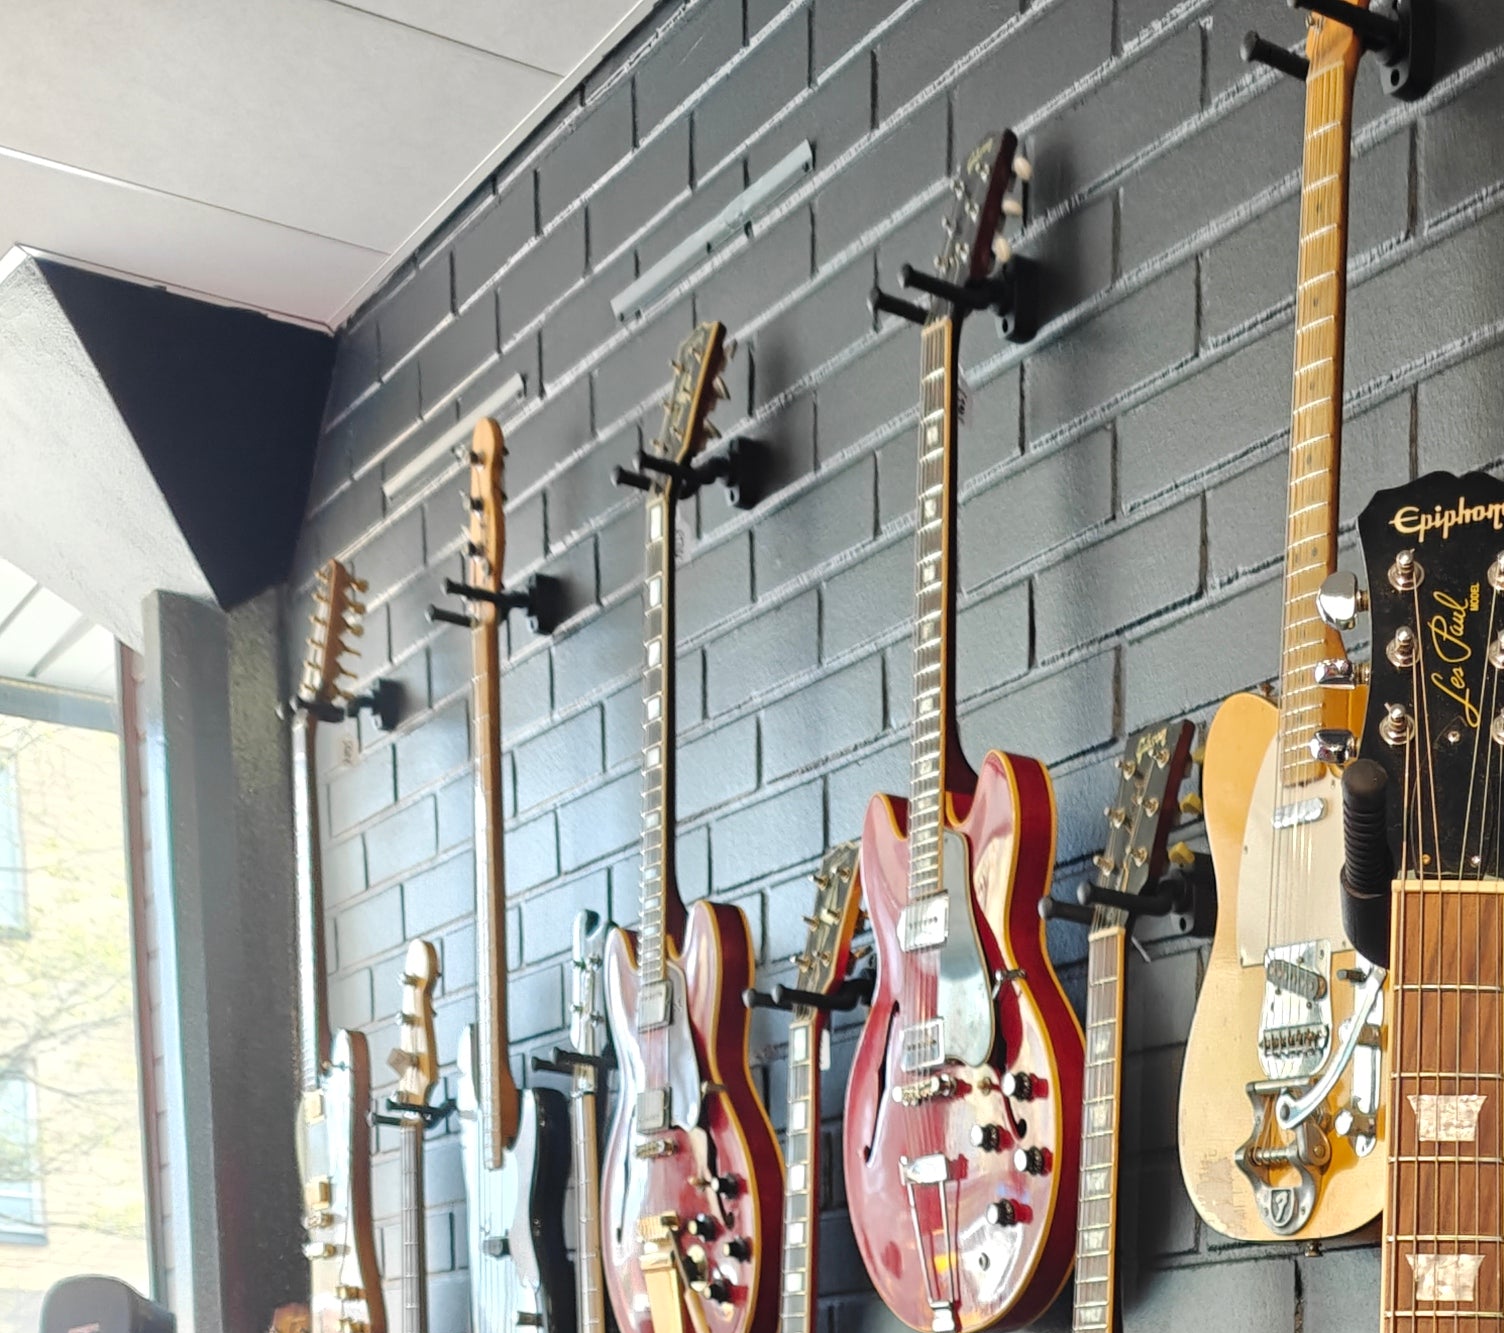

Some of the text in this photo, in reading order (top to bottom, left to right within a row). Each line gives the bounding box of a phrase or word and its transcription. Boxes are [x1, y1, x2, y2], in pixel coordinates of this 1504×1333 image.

[1469, 582, 1480, 611] MODEL
[1427, 591, 1480, 728] Les Paul
